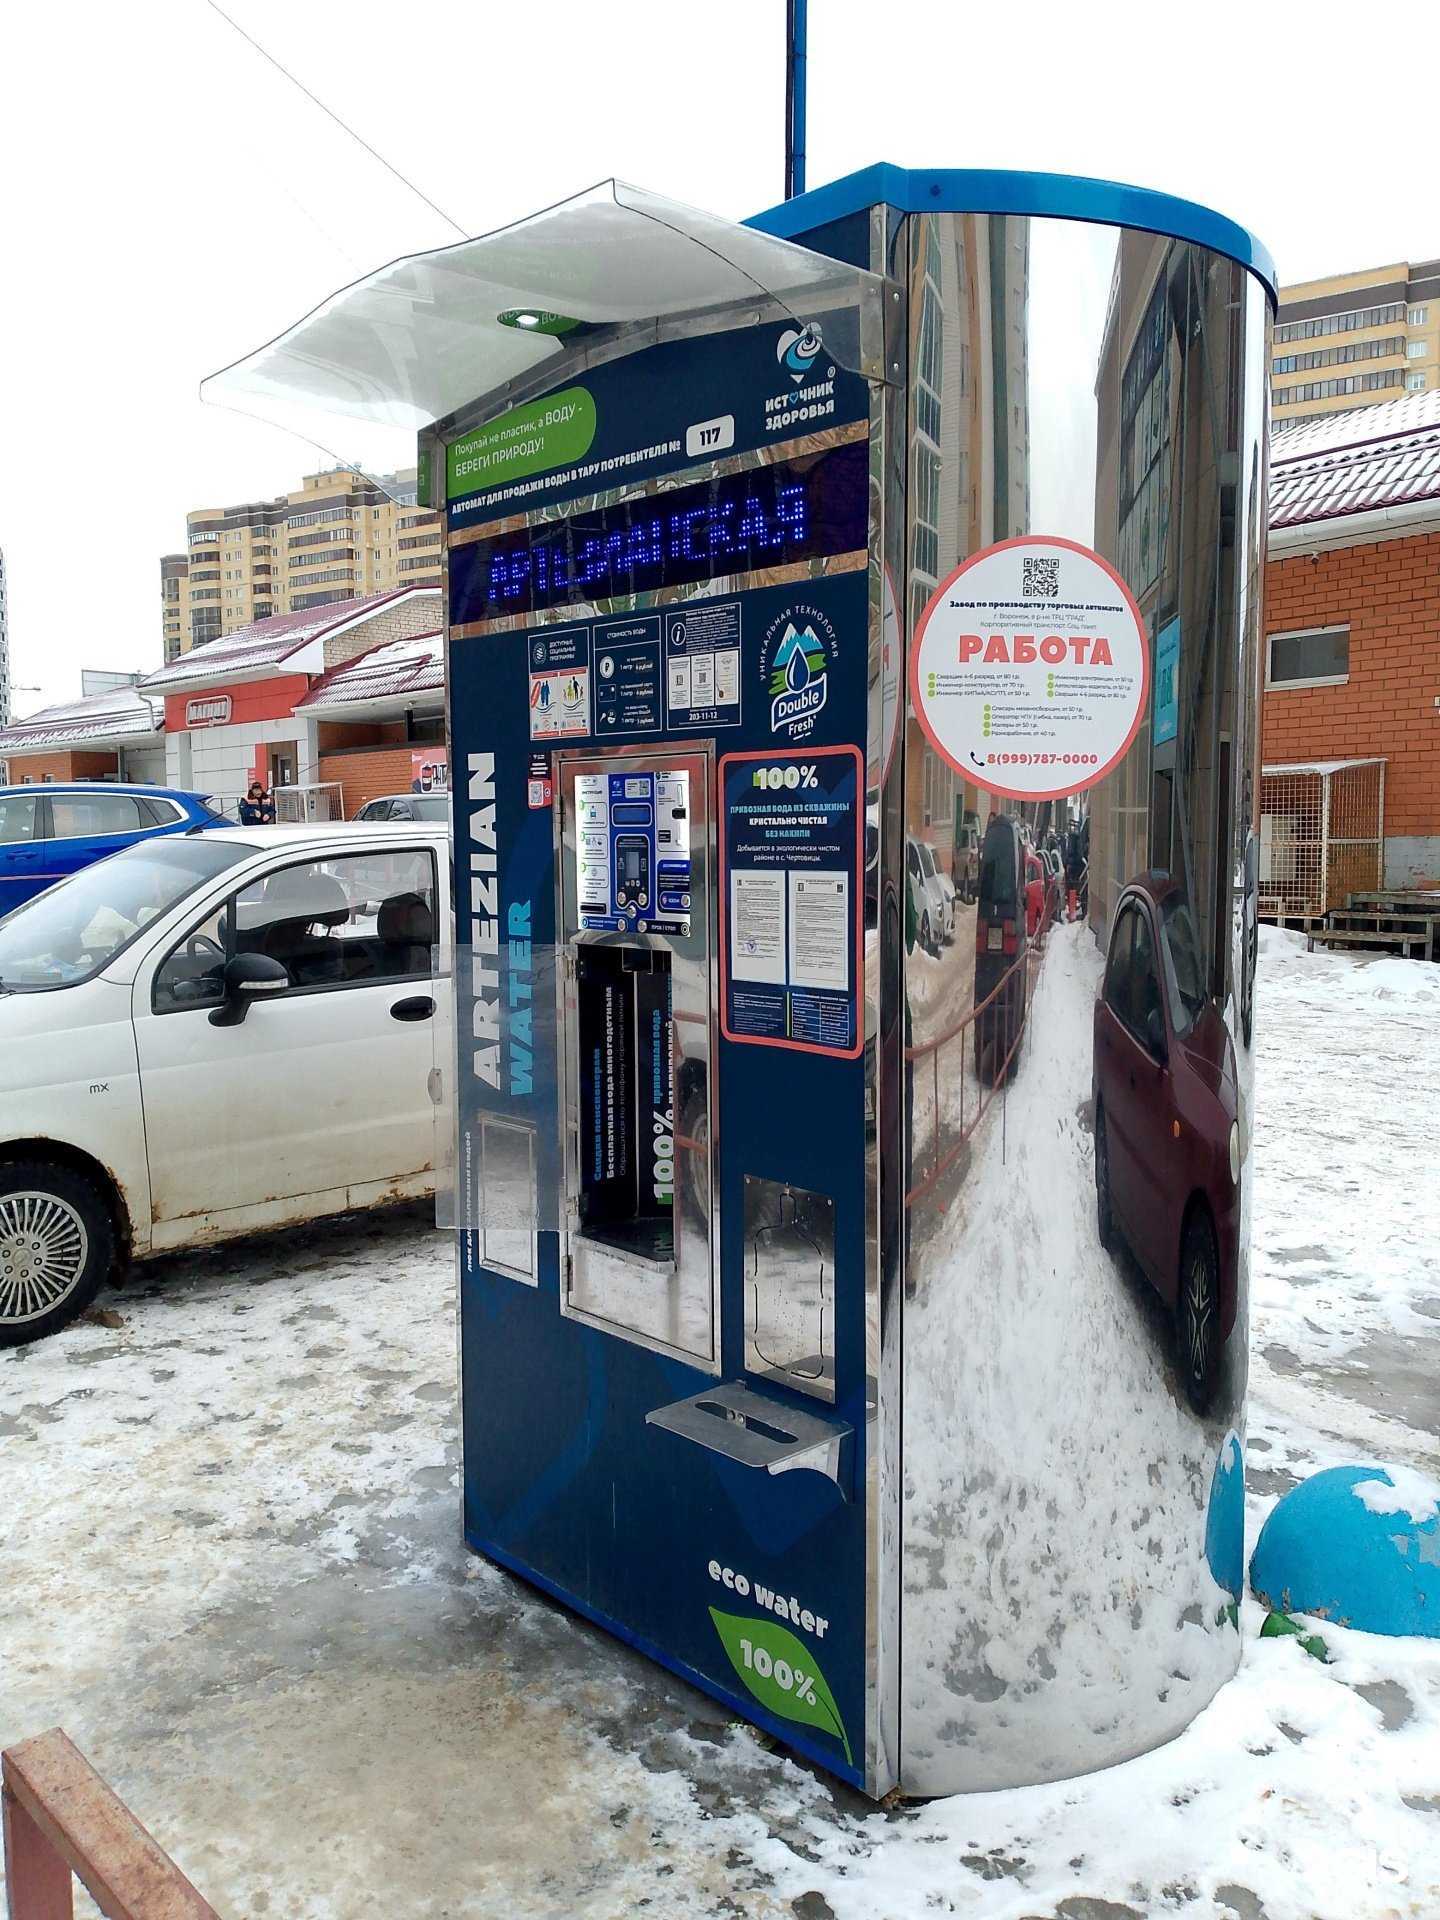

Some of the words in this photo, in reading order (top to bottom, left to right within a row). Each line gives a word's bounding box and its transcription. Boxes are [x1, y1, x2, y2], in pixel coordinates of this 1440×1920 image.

[455, 436, 488, 457] Покупай
[489, 433, 499, 444] не
[500, 422, 536, 441] пластик,
[538, 419, 544, 428] а
[545, 402, 576, 425] ВОДУ
[765, 399, 835, 431] ЗДОРОВЬЯ
[699, 427, 721, 446] 117
[455, 457, 491, 477] БЕРЕГИ
[492, 437, 544, 464] ПРИРОДУ!
[452, 496, 486, 515] АВТОМАТ
[486, 492, 503, 506] ДЛЯ
[503, 479, 544, 499] ПРОДАЖИ
[545, 471, 570, 488] ВОДЫ
[571, 470, 577, 481] В
[578, 462, 600, 478] ТАРУ
[600, 443, 668, 472] ПОТРЕБИТЕЛЯ
[669, 440, 681, 452] №
[949, 600, 975, 608] Завод
[988, 601, 1046, 610] производству
[1047, 602, 1084, 611] торговых
[1085, 604, 1123, 612] автоматов
[759, 608, 791, 681] УНИКАЛЬНАЯ
[795, 605, 839, 658] ТЕХНОЛОГИЯ
[958, 635, 1113, 665] РАБОТА
[689, 711, 718, 721] 203-11-12
[778, 689, 820, 717] Double
[788, 717, 814, 736] Fresh
[987, 753, 1098, 766] 8(999)787-0000
[757, 765, 818, 790] 100%
[730, 804, 771, 814] ПРИВОЗНАЯ
[772, 804, 793, 814] ВОДА
[794, 804, 804, 812] ИЗ
[804, 802, 850, 812] СКВАЖИНЫ
[749, 816, 797, 826] КРИСТАЛЬНО
[798, 816, 828, 825] ЧИСТАЯ
[736, 844, 770, 853] Добывается
[765, 830, 778, 838] БЕЗ
[753, 854, 775, 862] районе
[468, 752, 501, 1090] ARTEZIAN
[508, 899, 533, 1096] WATER
[604, 987, 613, 1074] многодетным
[652, 1009, 661, 1037] вода
[652, 1039, 662, 1104] привозная
[606, 1076, 614, 1105] вода
[606, 1107, 615, 1178] Бесплатная
[653, 1109, 673, 1199] 100%
[708, 1559, 750, 1596] eco
[754, 1583, 829, 1638] water
[740, 1639, 817, 1706] 100%
